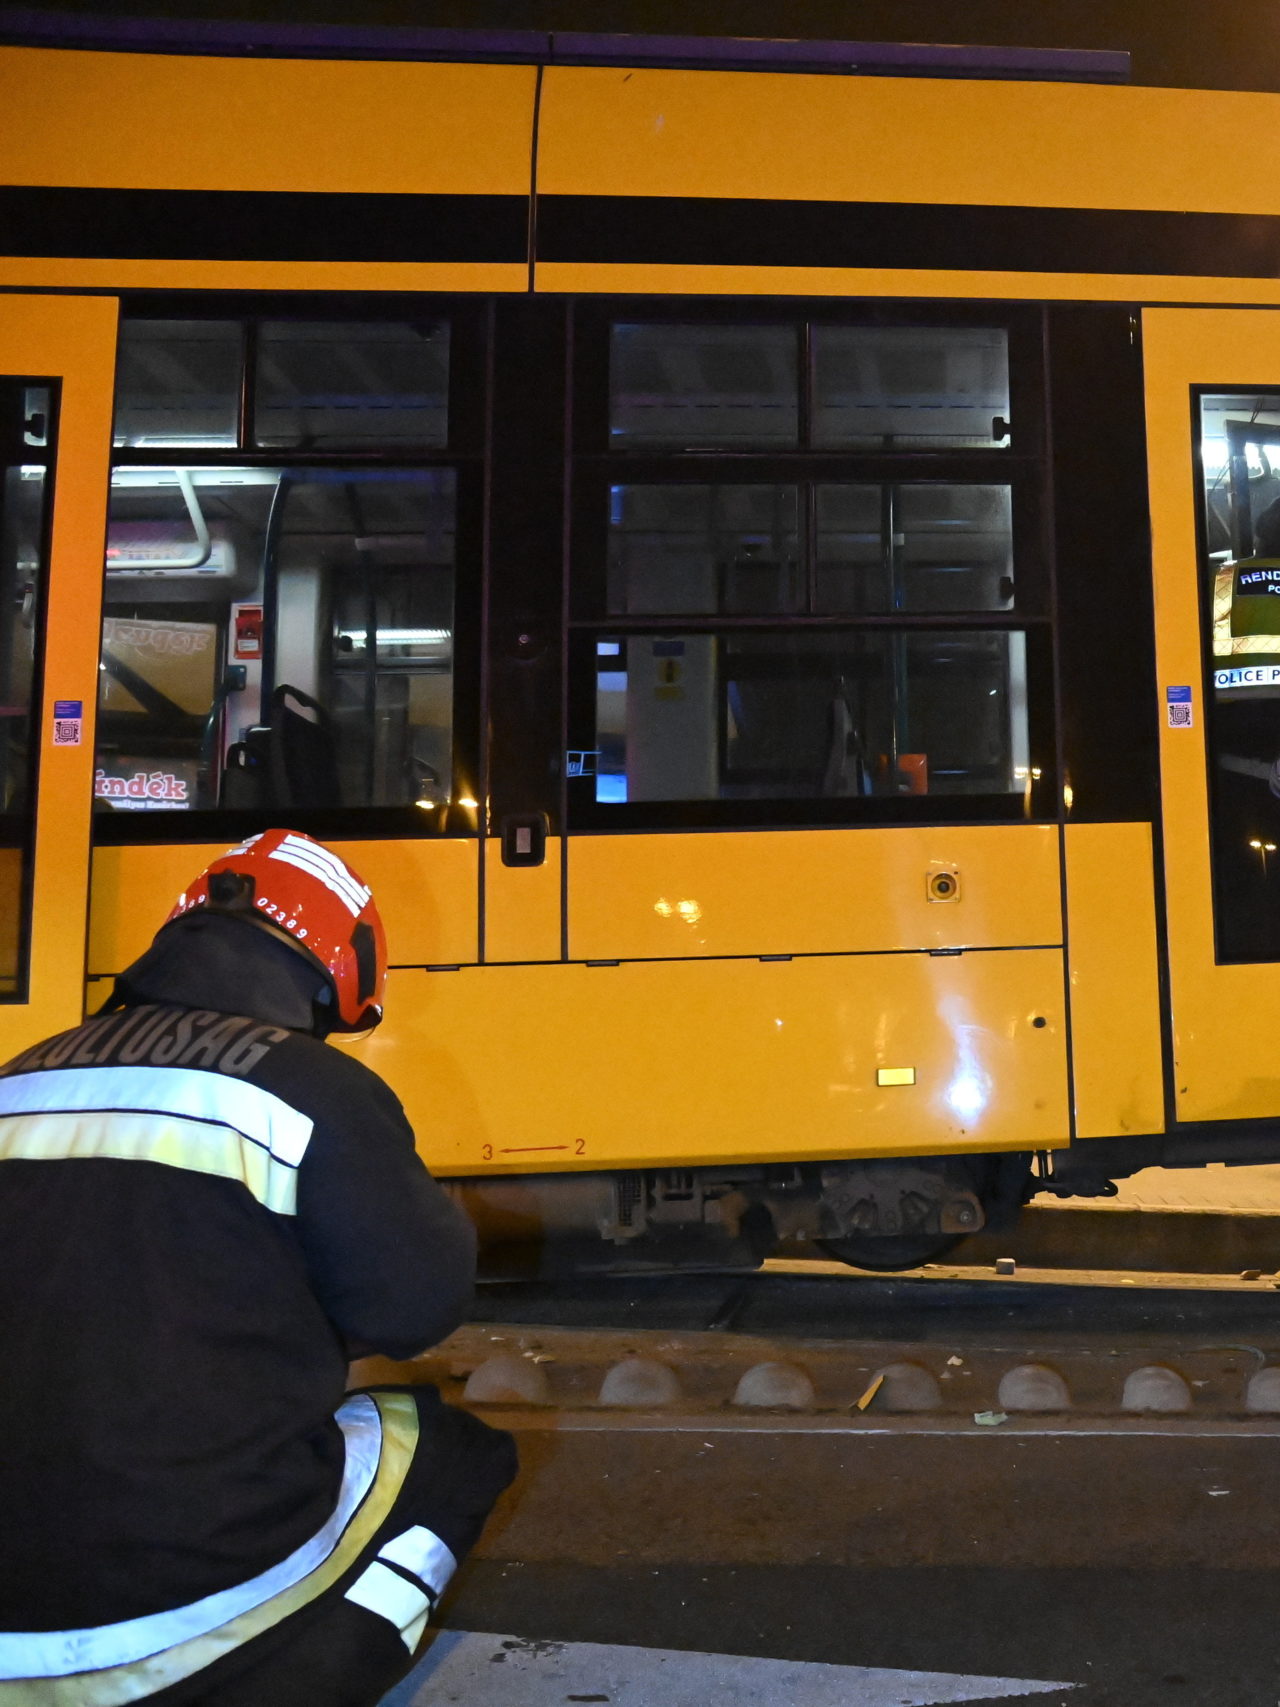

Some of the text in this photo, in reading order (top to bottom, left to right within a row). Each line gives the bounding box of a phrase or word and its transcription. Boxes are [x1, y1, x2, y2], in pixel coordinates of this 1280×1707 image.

[1215, 670, 1263, 685] OLICE
[257, 897, 308, 939] 02389
[482, 1138, 586, 1161] 3 2
